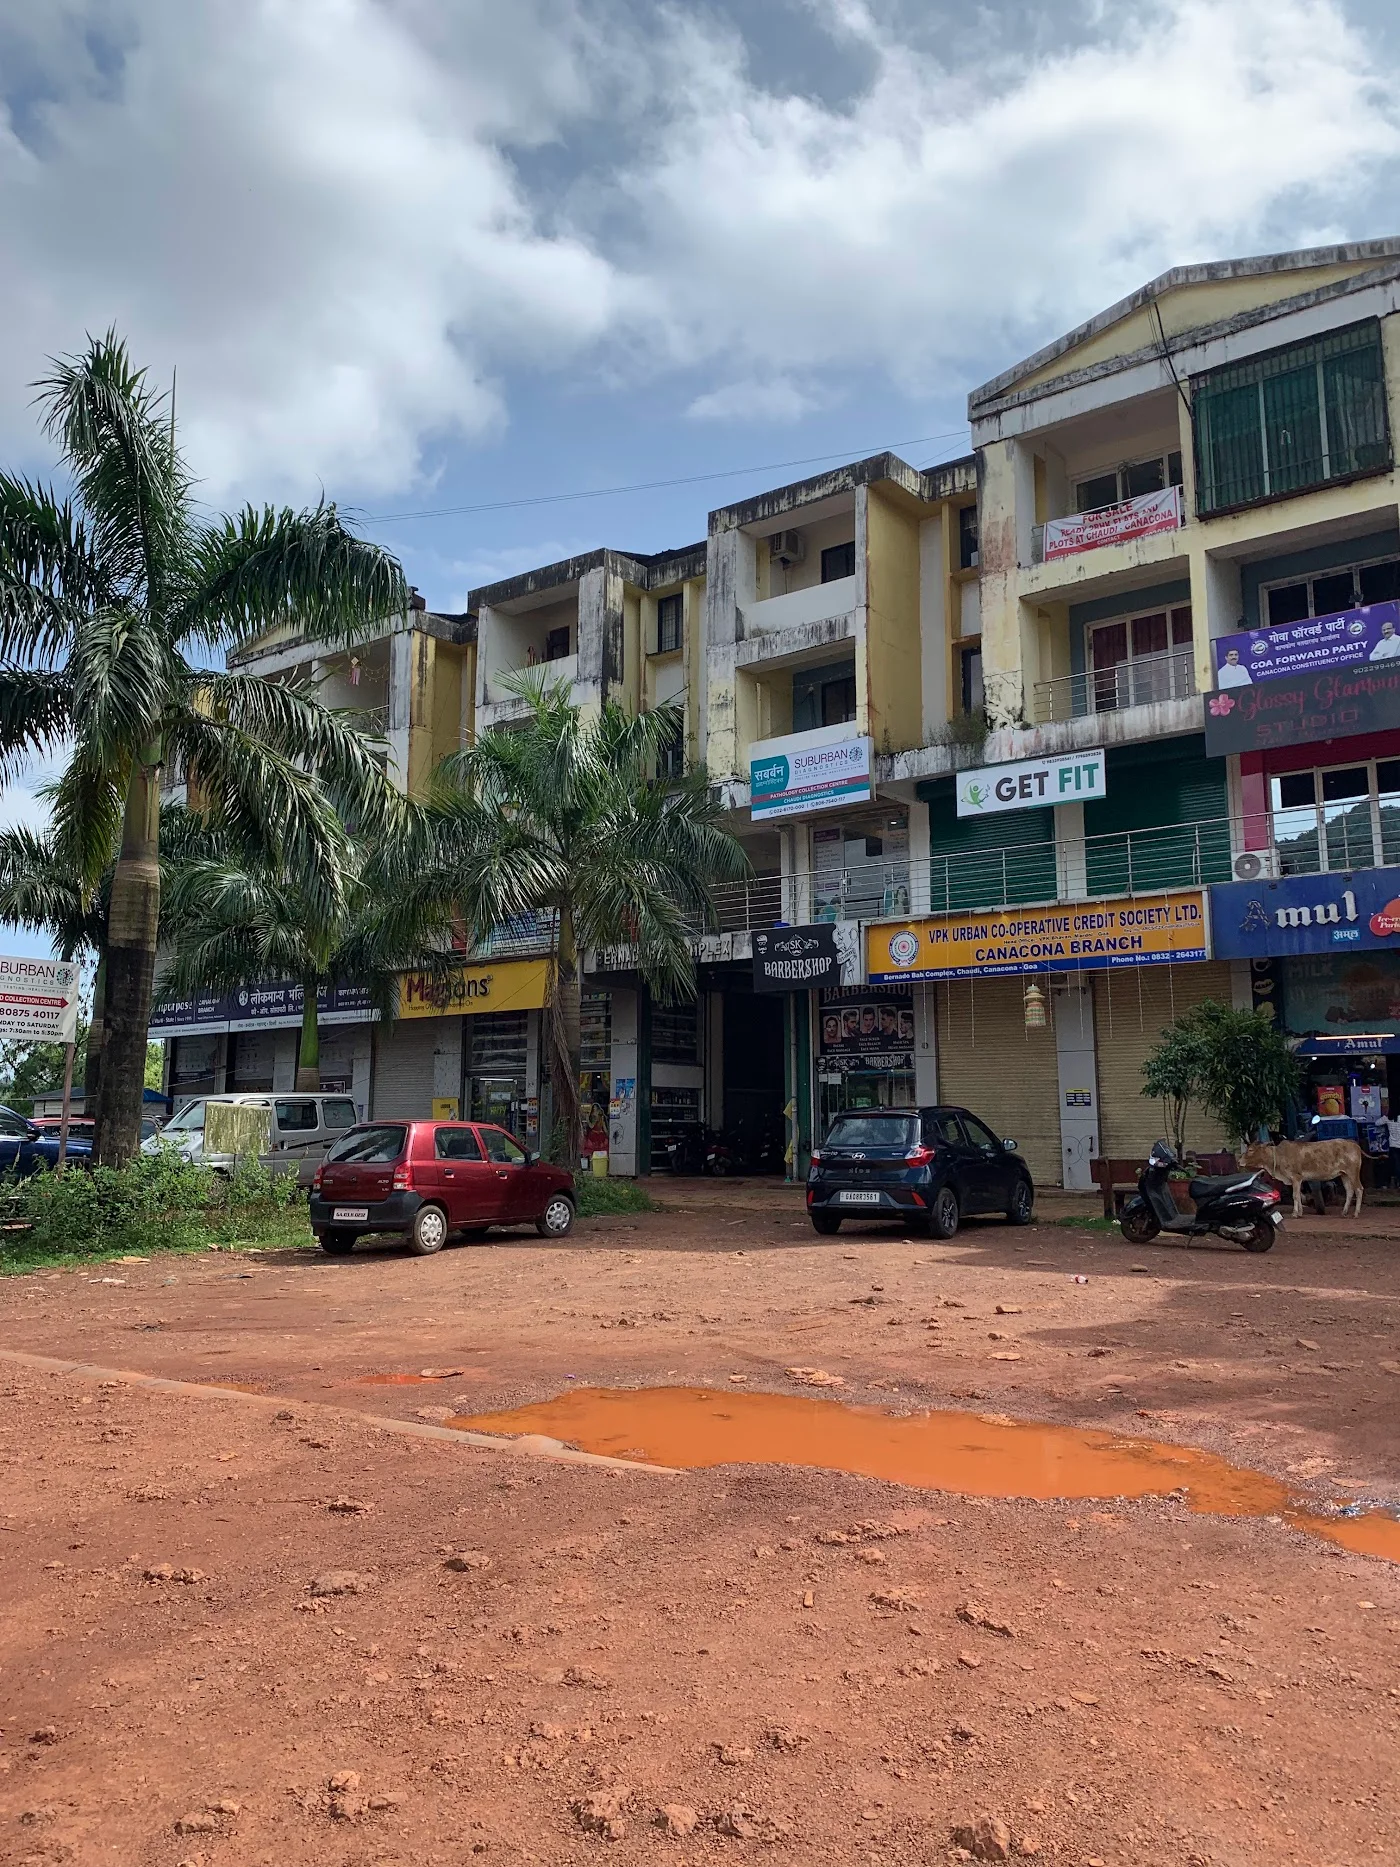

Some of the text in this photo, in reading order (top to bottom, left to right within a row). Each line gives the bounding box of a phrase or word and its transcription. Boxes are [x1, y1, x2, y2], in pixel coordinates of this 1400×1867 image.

[1083, 503, 1133, 524] FOR SALE
[1049, 537, 1075, 550] PLOTS
[1075, 534, 1084, 545] AT
[1086, 525, 1118, 541] CHAUDI
[1125, 509, 1173, 530] CANACONA
[1061, 525, 1091, 537] READY
[1096, 534, 1121, 546] CONTACT
[1269, 617, 1346, 644] गोवा फॉरवर्ड पार्टी
[1251, 640, 1368, 670] GOA FORWARD PARTY
[1256, 652, 1364, 677] CANACONA CONSTITUENCY OFFICE
[1256, 708, 1358, 737] STUDIO
[794, 748, 848, 769] SUBURBAN
[794, 760, 848, 775] DIAGNOSTICS
[754, 763, 784, 781] सबर्बन
[770, 779, 849, 799] PATHOLOGY COLLECTION CENTRE
[995, 762, 1099, 802] GET FIT
[783, 789, 835, 804] CHAUDI DIAGNOSTICS
[1239, 890, 1359, 932] Amul
[929, 928, 949, 944] VPK
[952, 925, 988, 942] URBAN
[991, 917, 1070, 939] CO-OPERATIVE
[1074, 912, 1115, 930] CREDIT
[1119, 907, 1171, 927] SOCIETY
[1175, 904, 1202, 921] LTD.
[790, 940, 803, 950] SK
[975, 935, 1142, 961] CANACONA BRANCH
[1111, 955, 1134, 964] Phone
[1135, 954, 1150, 962] No.:
[1151, 952, 1170, 961] 0832
[764, 956, 832, 980] BARBERSHOP
[925, 968, 955, 977] Complex,
[957, 966, 982, 975] Chaudi,
[983, 964, 1018, 973] Canacona
[5, 995, 40, 1003] COLLECTION
[40, 998, 61, 1006] CENTRE
[250, 989, 285, 1005] लोकमान्य
[33, 1011, 60, 1020] 40117
[1345, 1038, 1383, 1049] Amul
[865, 1055, 905, 1068] BARBERSHOP
